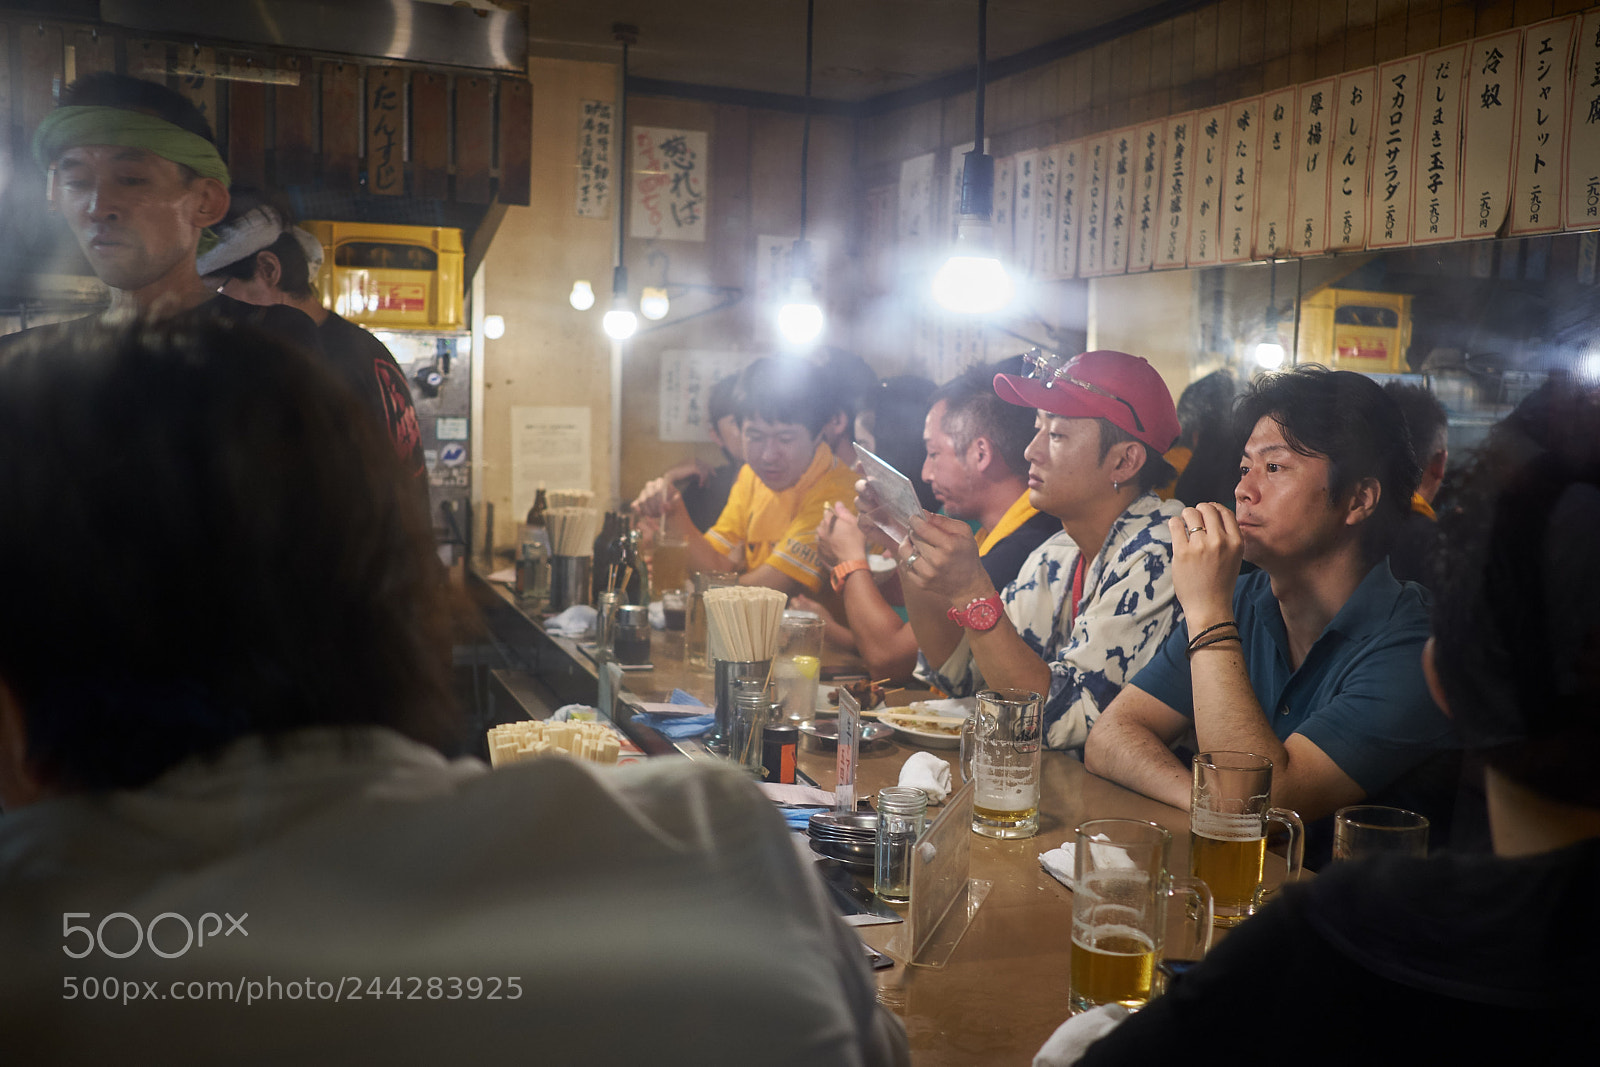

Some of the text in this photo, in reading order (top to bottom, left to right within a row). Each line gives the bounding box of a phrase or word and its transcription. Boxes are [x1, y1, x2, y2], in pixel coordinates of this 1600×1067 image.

[1480, 47, 1504, 110] 冷奴
[1533, 37, 1553, 175] エシャレット
[1341, 85, 1364, 196] おしんこ
[1384, 73, 1407, 202] マカロニサラダ
[1427, 61, 1451, 195] だしまき玉子
[1429, 198, 1440, 234] 二九〇円
[1479, 191, 1491, 229] 二九〇円
[1529, 185, 1542, 224] 二九〇円
[1586, 176, 1600, 217] 二九〇円
